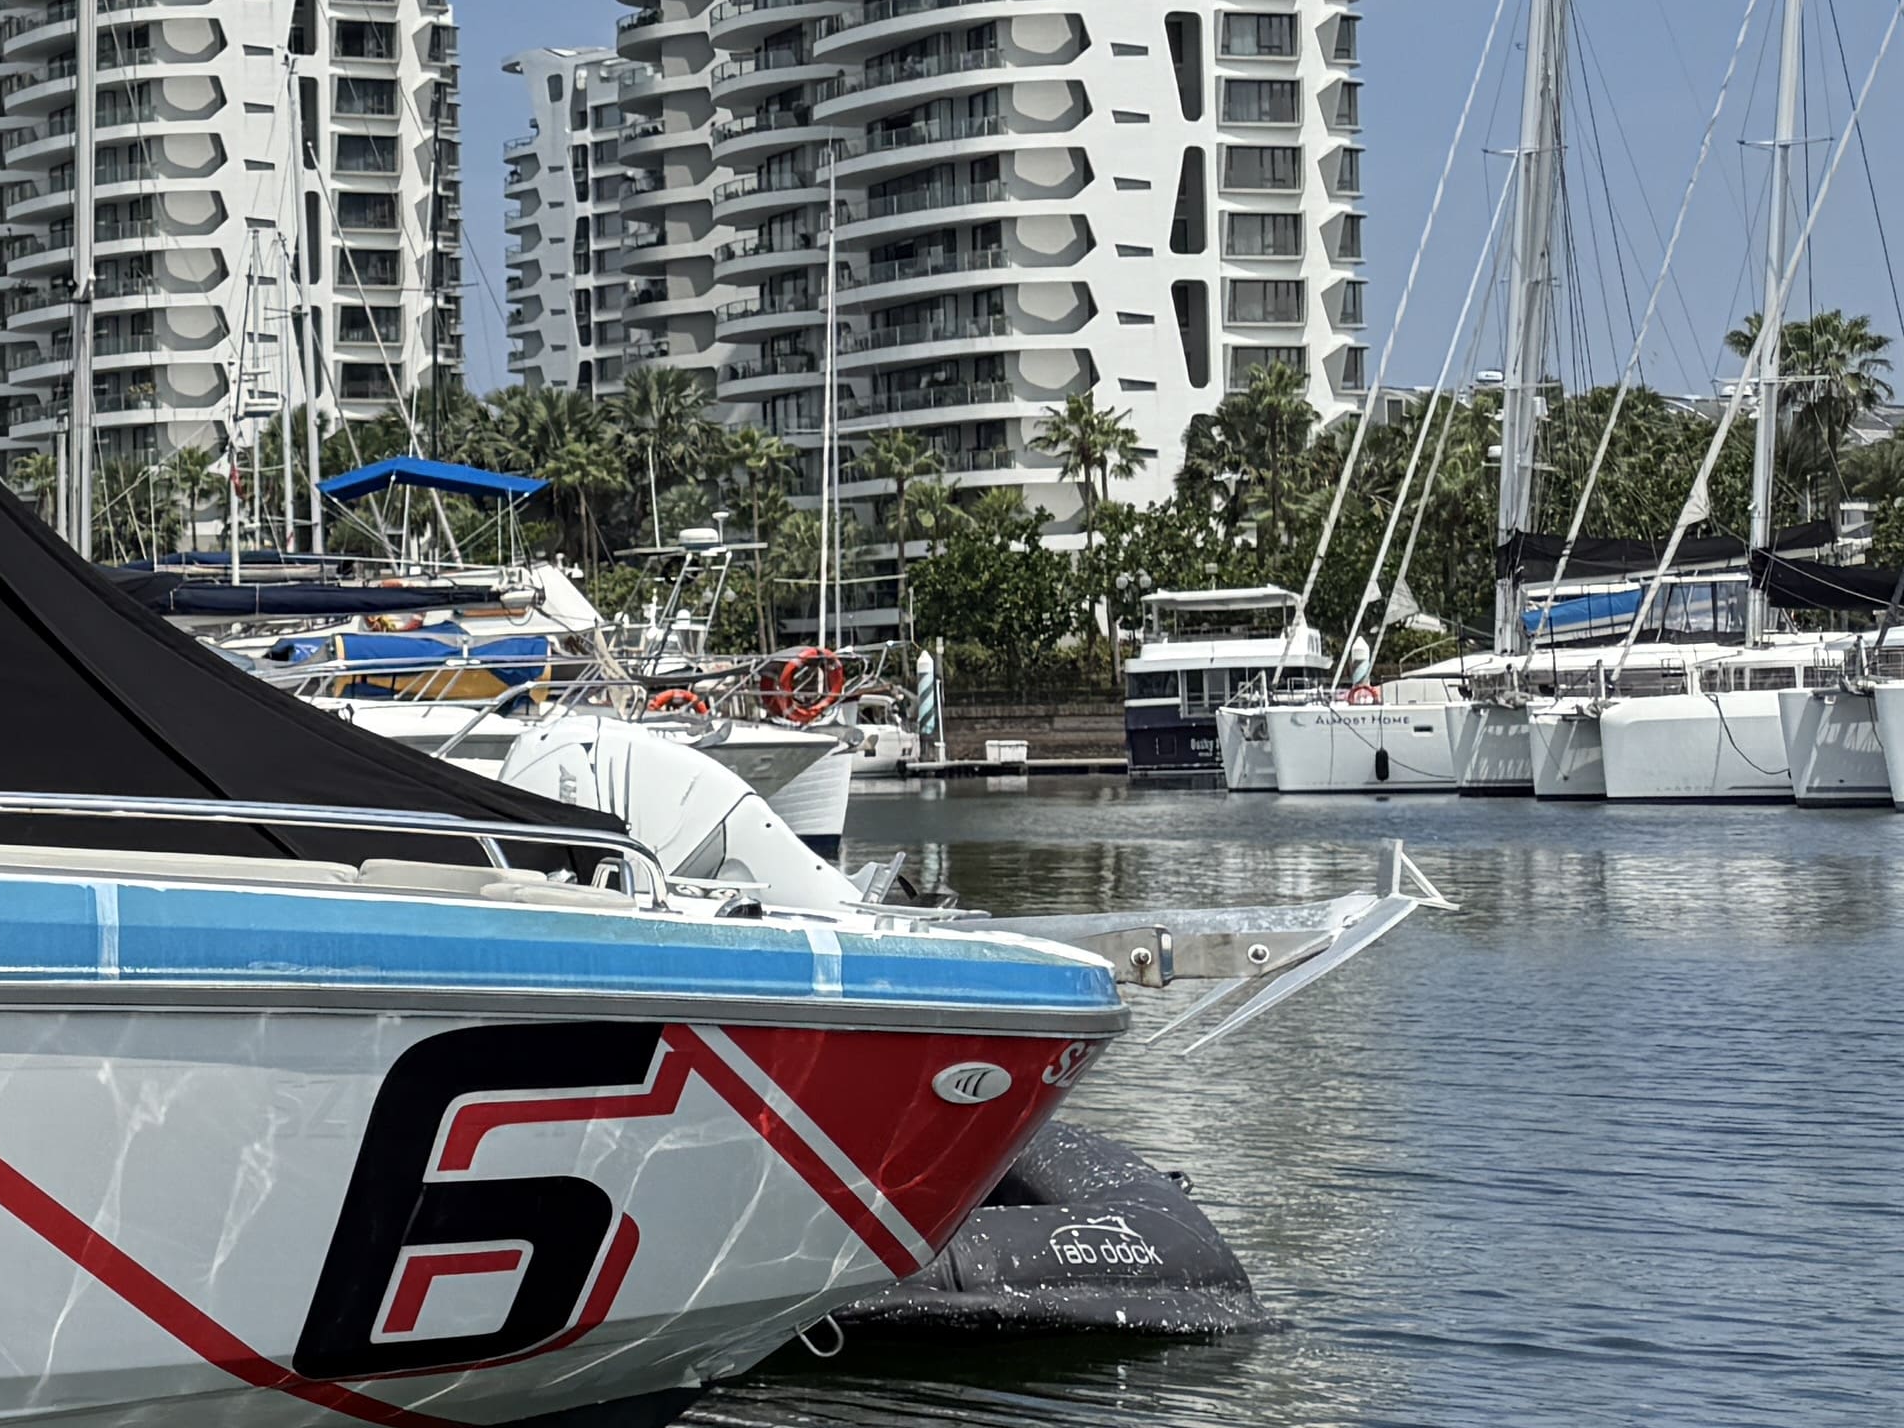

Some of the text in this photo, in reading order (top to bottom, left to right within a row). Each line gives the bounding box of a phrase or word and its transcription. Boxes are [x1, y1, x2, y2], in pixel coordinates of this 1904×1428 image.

[1371, 714, 1411, 726] HOME
[291, 1020, 666, 1381] 6
[1049, 1237, 1164, 1266] fab dock
